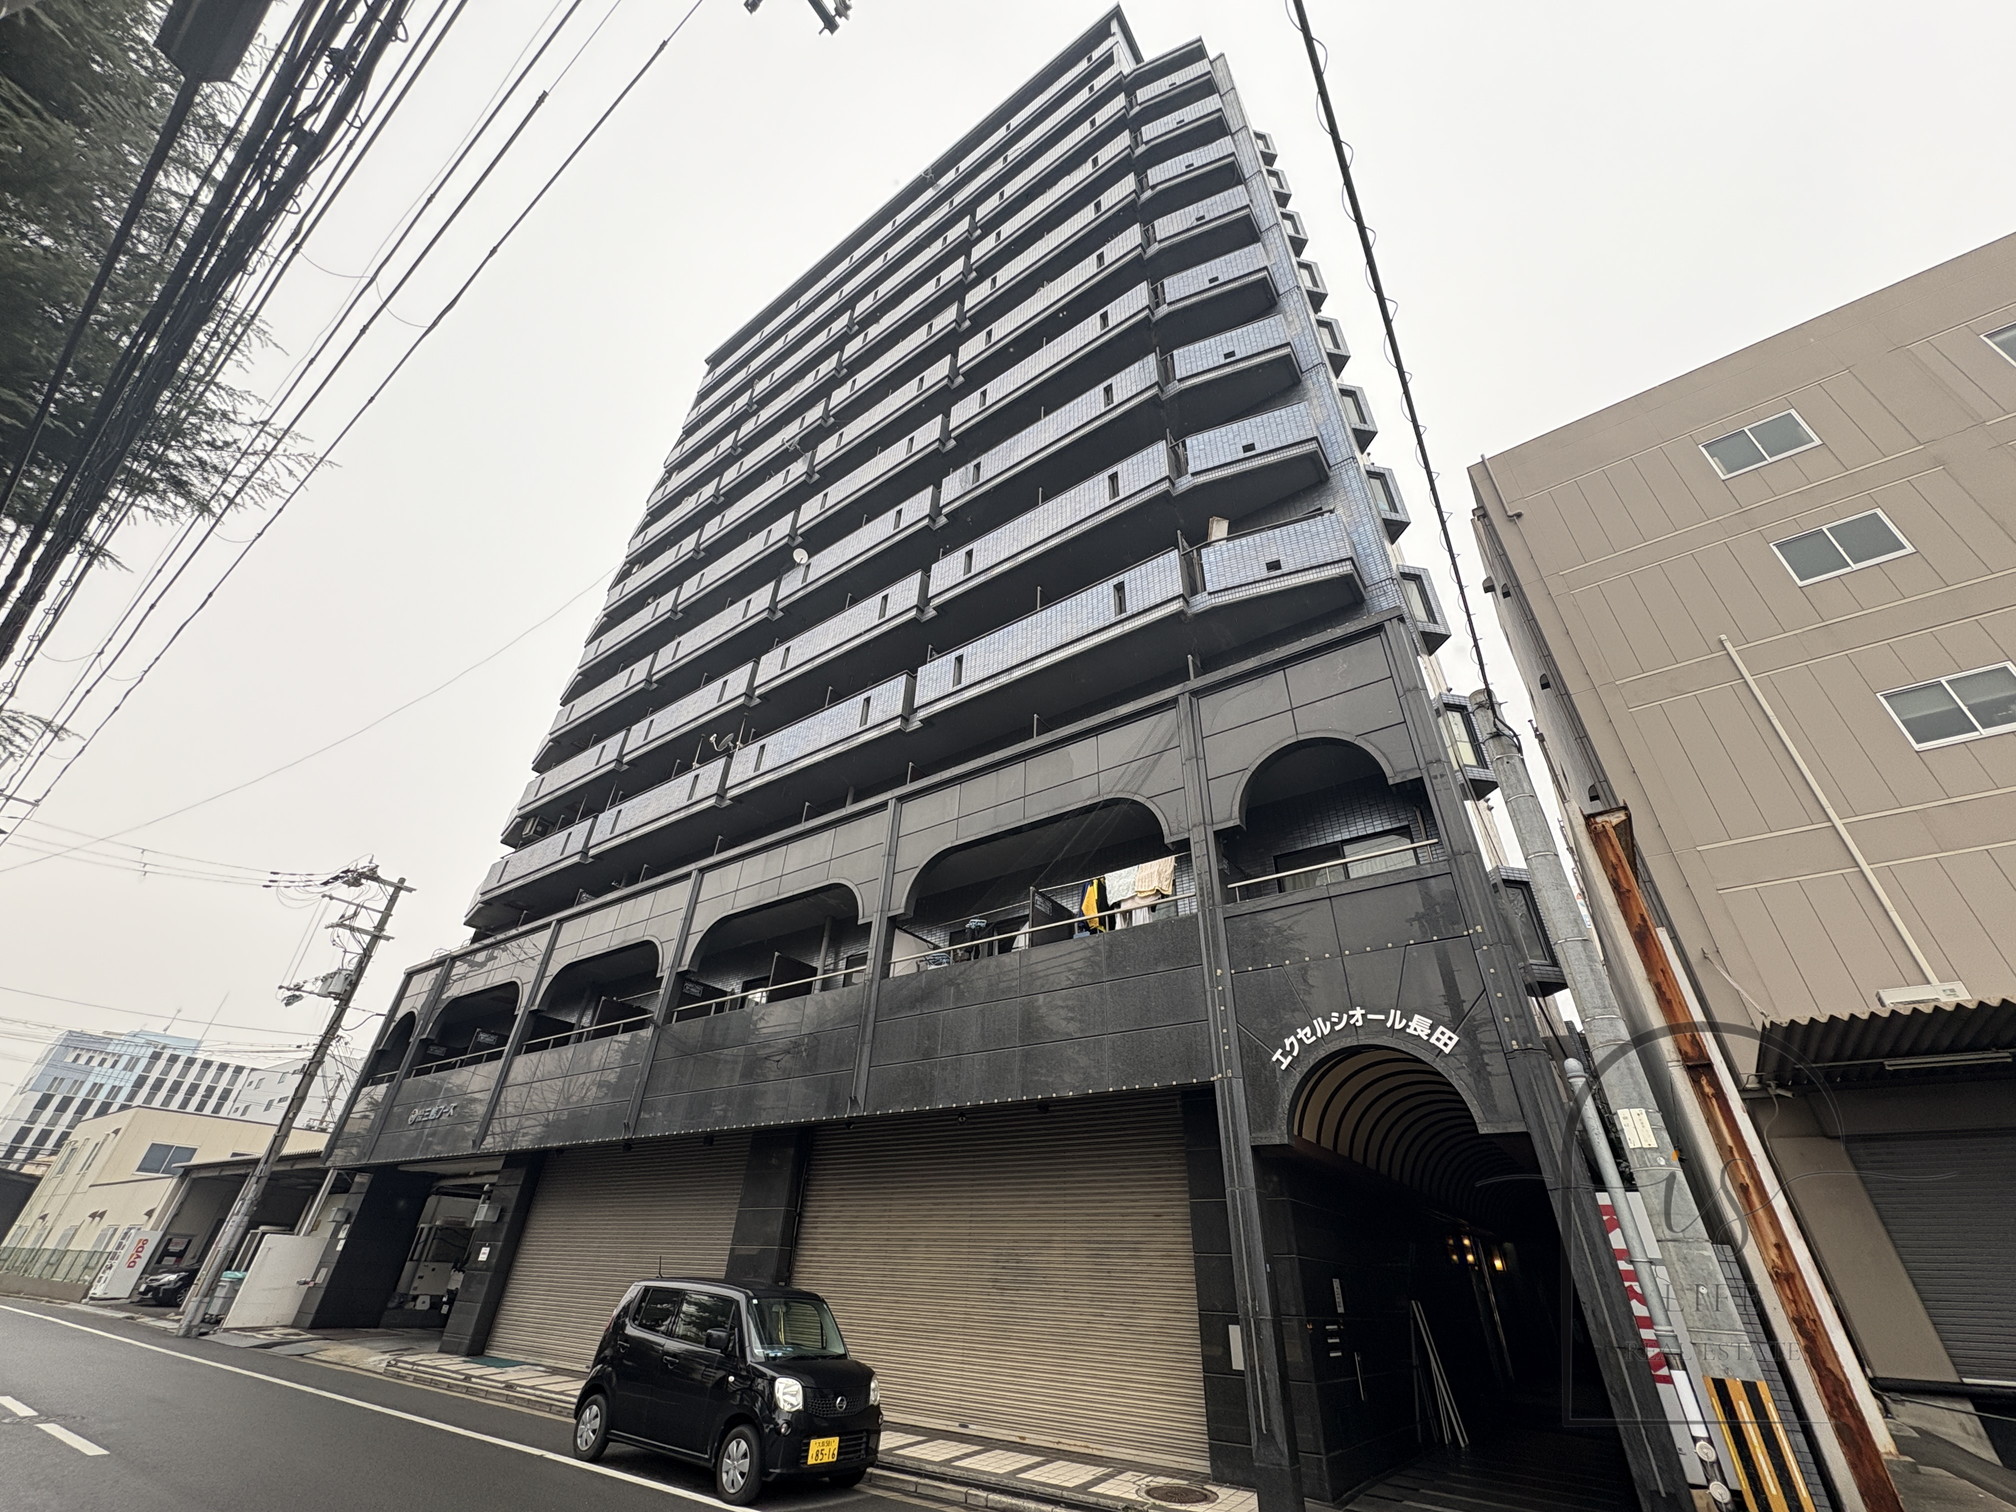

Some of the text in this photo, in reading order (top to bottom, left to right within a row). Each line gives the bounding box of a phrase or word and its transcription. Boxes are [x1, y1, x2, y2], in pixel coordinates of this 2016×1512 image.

[1271, 1006, 1460, 1071] エクセルシオール長田
